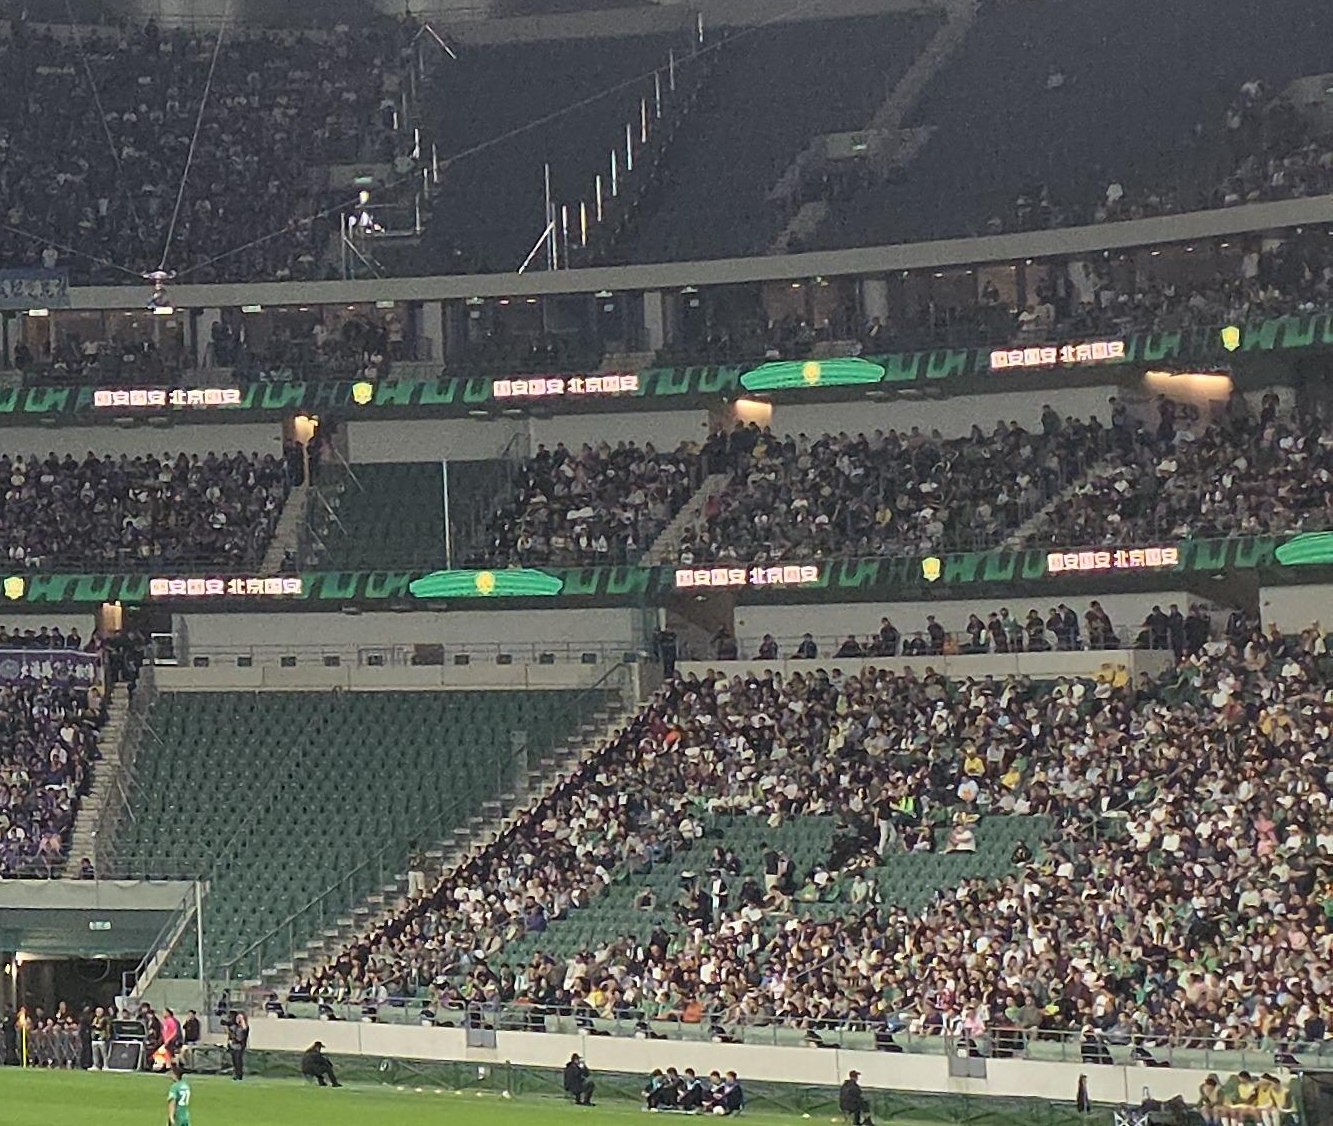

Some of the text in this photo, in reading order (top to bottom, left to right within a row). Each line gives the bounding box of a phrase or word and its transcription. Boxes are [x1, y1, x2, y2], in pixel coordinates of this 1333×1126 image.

[991, 342, 1125, 368] 国安国安 北京国安
[494, 376, 638, 396] 国安国安 北京国安
[94, 389, 241, 406] 国安国安 北京国安
[1047, 548, 1178, 571] 国安国安 北京国安
[676, 566, 818, 586] 国安国安 北京国安
[150, 578, 302, 595] 国安国安 北京国安
